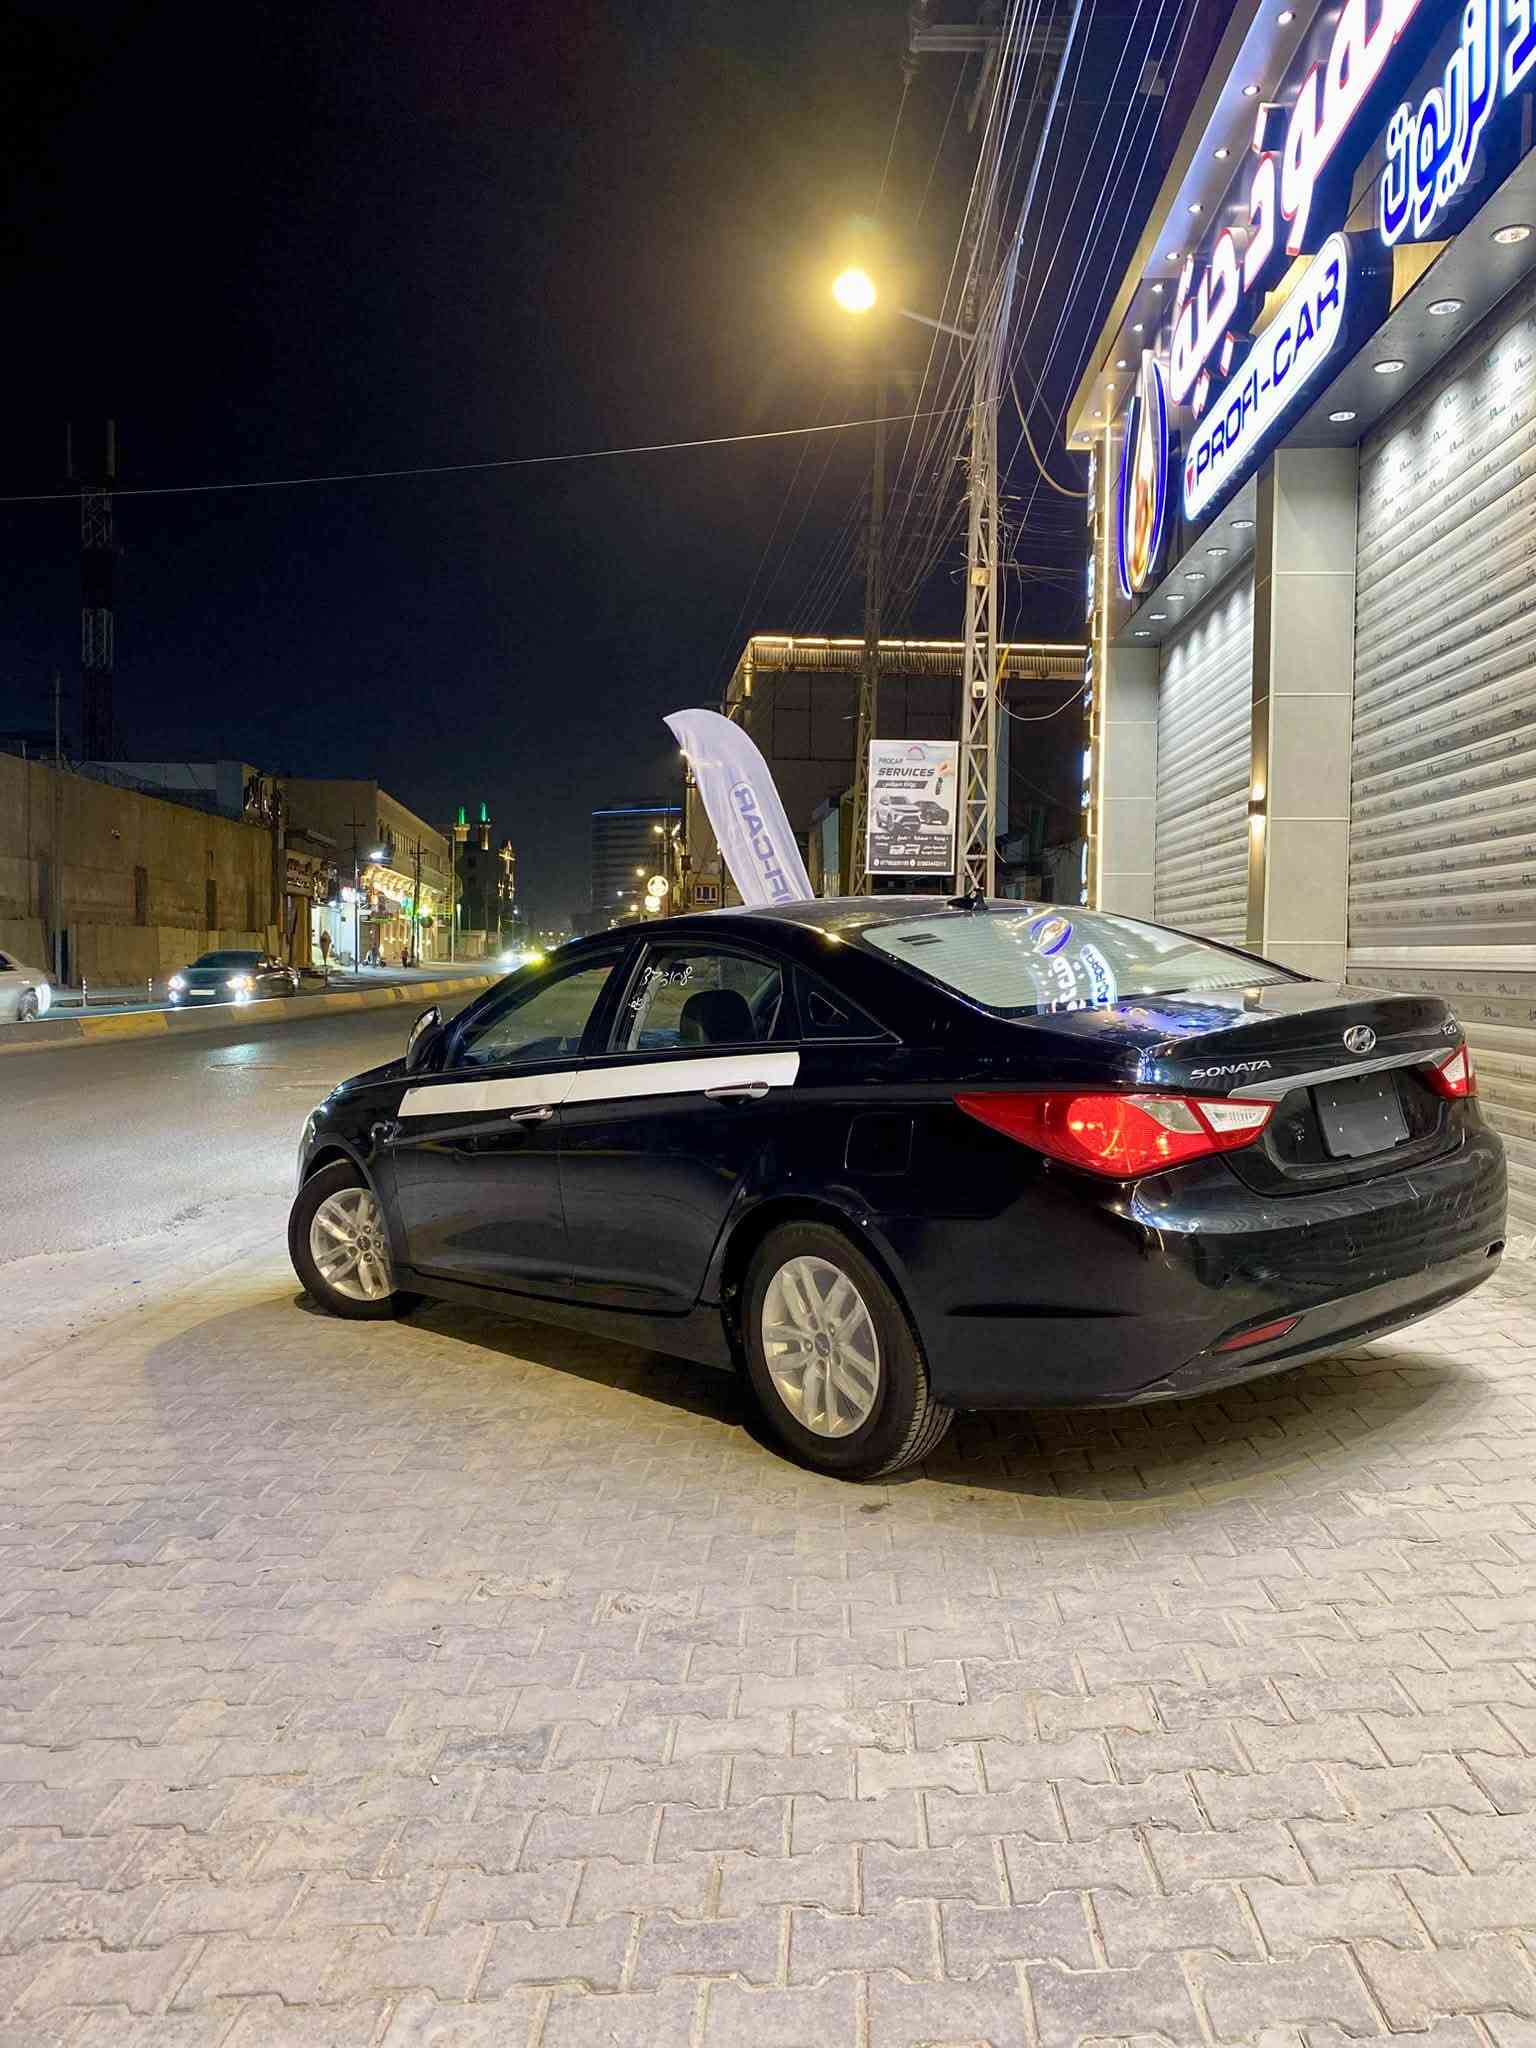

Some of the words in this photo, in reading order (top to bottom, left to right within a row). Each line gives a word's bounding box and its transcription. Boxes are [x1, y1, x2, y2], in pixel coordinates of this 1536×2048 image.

[1196, 258, 1340, 484] PROFI-CAR
[877, 767, 936, 778] SERVICES
[1190, 1059, 1273, 1080] SONATA
